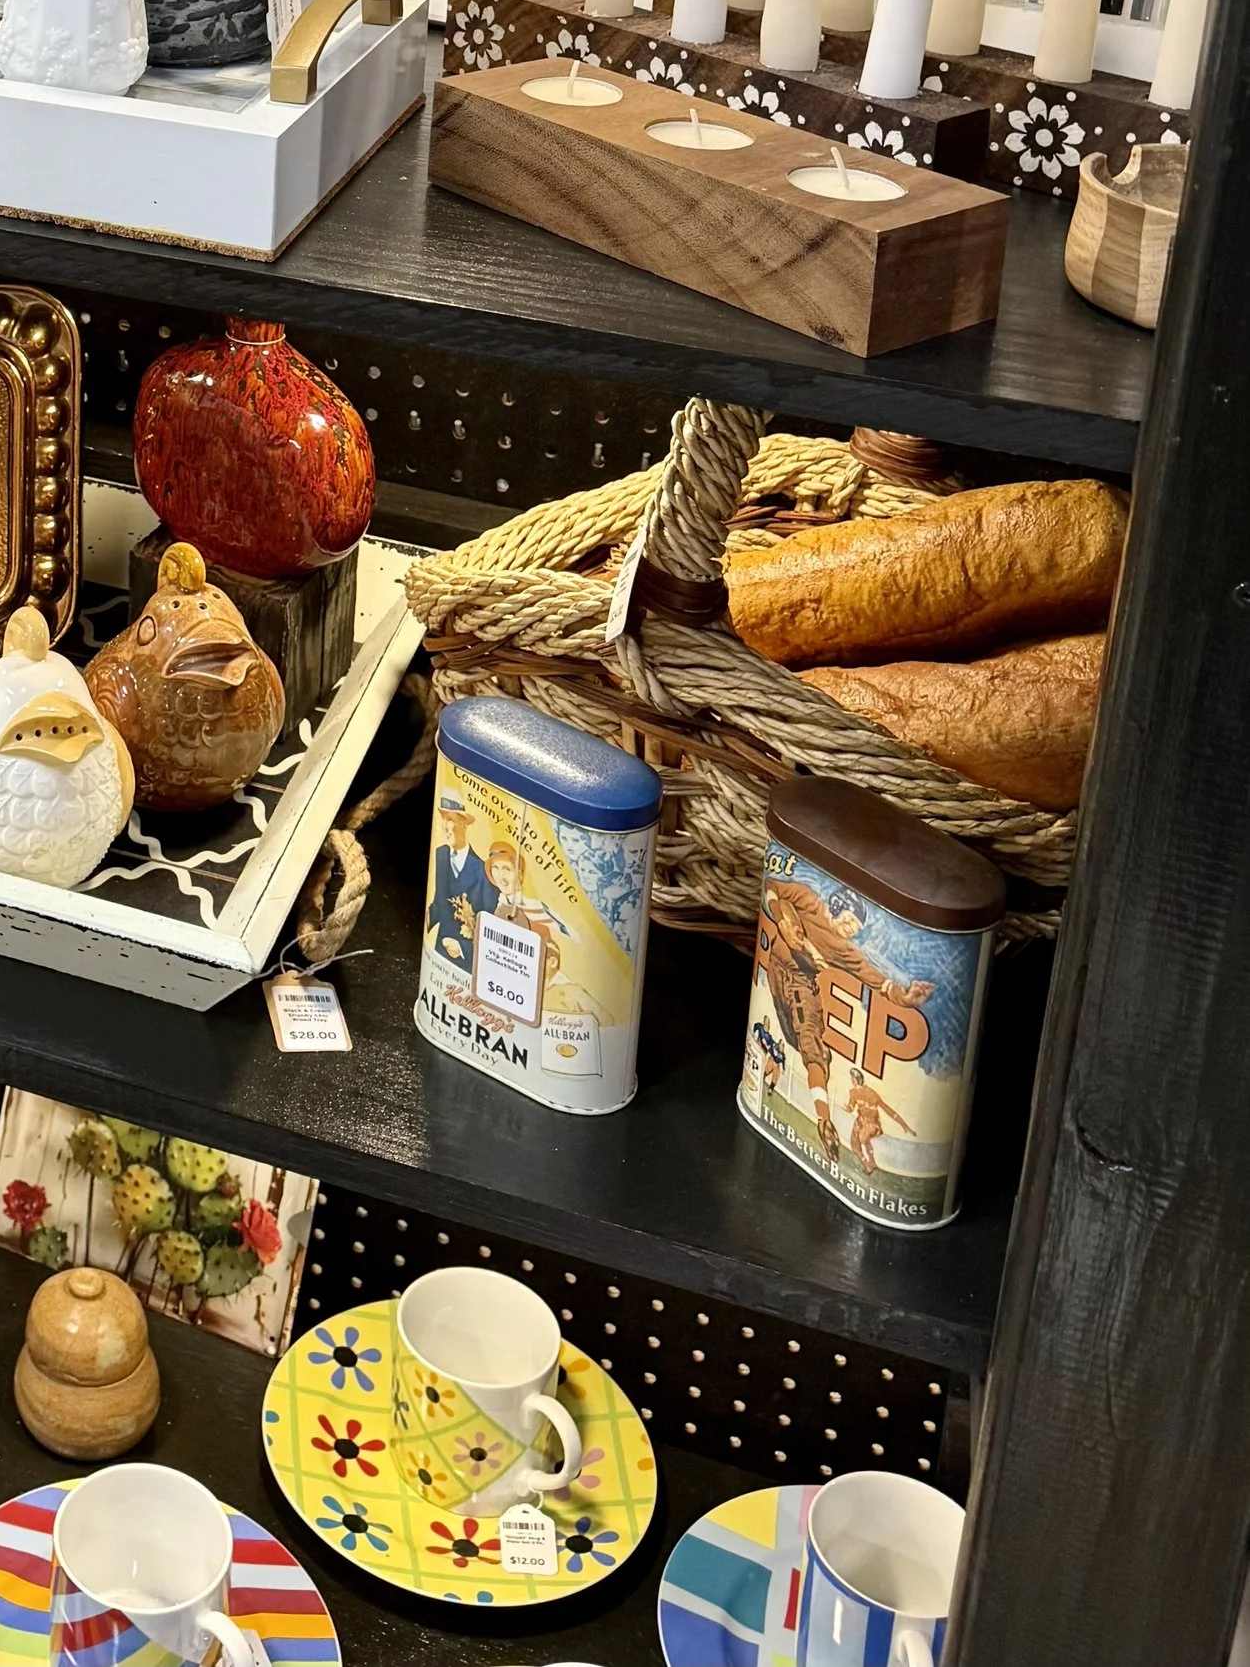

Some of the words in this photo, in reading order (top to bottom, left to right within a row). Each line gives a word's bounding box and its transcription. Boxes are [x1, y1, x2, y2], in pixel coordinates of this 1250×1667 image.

[453, 767, 488, 798] Come
[491, 794, 521, 822] over
[523, 822, 538, 840] to
[541, 841, 565, 870] the
[467, 792, 503, 824] sunny
[505, 824, 533, 854] side
[535, 854, 556, 872] of
[553, 873, 578, 904] life
[487, 980, 524, 1005] $8.00
[289, 1030, 337, 1040] $28.00
[419, 986, 529, 1071] ALL-BRAN
[431, 1017, 465, 1049] Every
[471, 1042, 499, 1066] Day
[762, 1103, 786, 1136] The
[786, 1124, 829, 1169] Better
[830, 1160, 866, 1200] Bran
[868, 1187, 928, 1217] Flakes
[509, 1556, 545, 1566] $12.00
